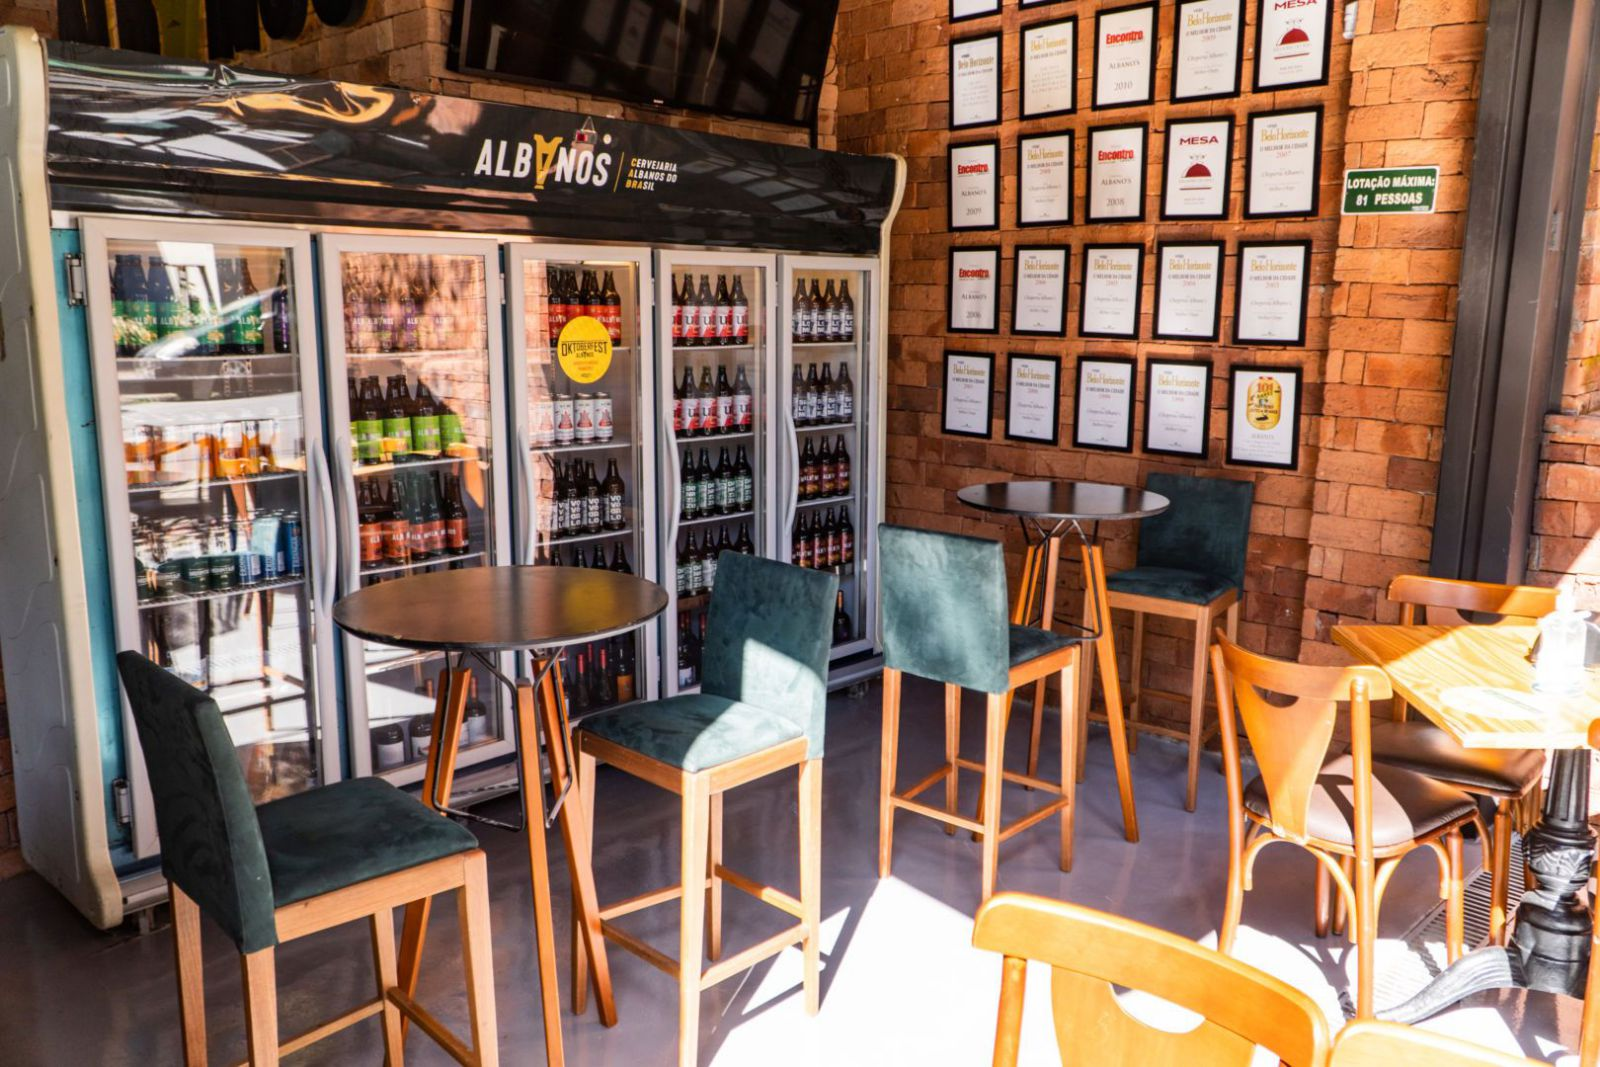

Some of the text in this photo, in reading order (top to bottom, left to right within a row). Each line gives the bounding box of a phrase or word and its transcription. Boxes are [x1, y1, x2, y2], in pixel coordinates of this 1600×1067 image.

[1106, 30, 1144, 44] Encontro
[1180, 136, 1218, 145] MESA
[1098, 150, 1134, 161] Encontro
[631, 158, 677, 172] CERVEJARIA
[958, 164, 988, 174] Encontro
[628, 169, 678, 182] ALBANOS DO
[625, 180, 654, 190] BRASIL
[1348, 175, 1434, 190] LOTAÇÃO MÁXIMA:
[1356, 192, 1423, 206] 81 PESSOAS
[959, 268, 989, 278] Encontro
[562, 342, 607, 356] OKTOBERFEST
